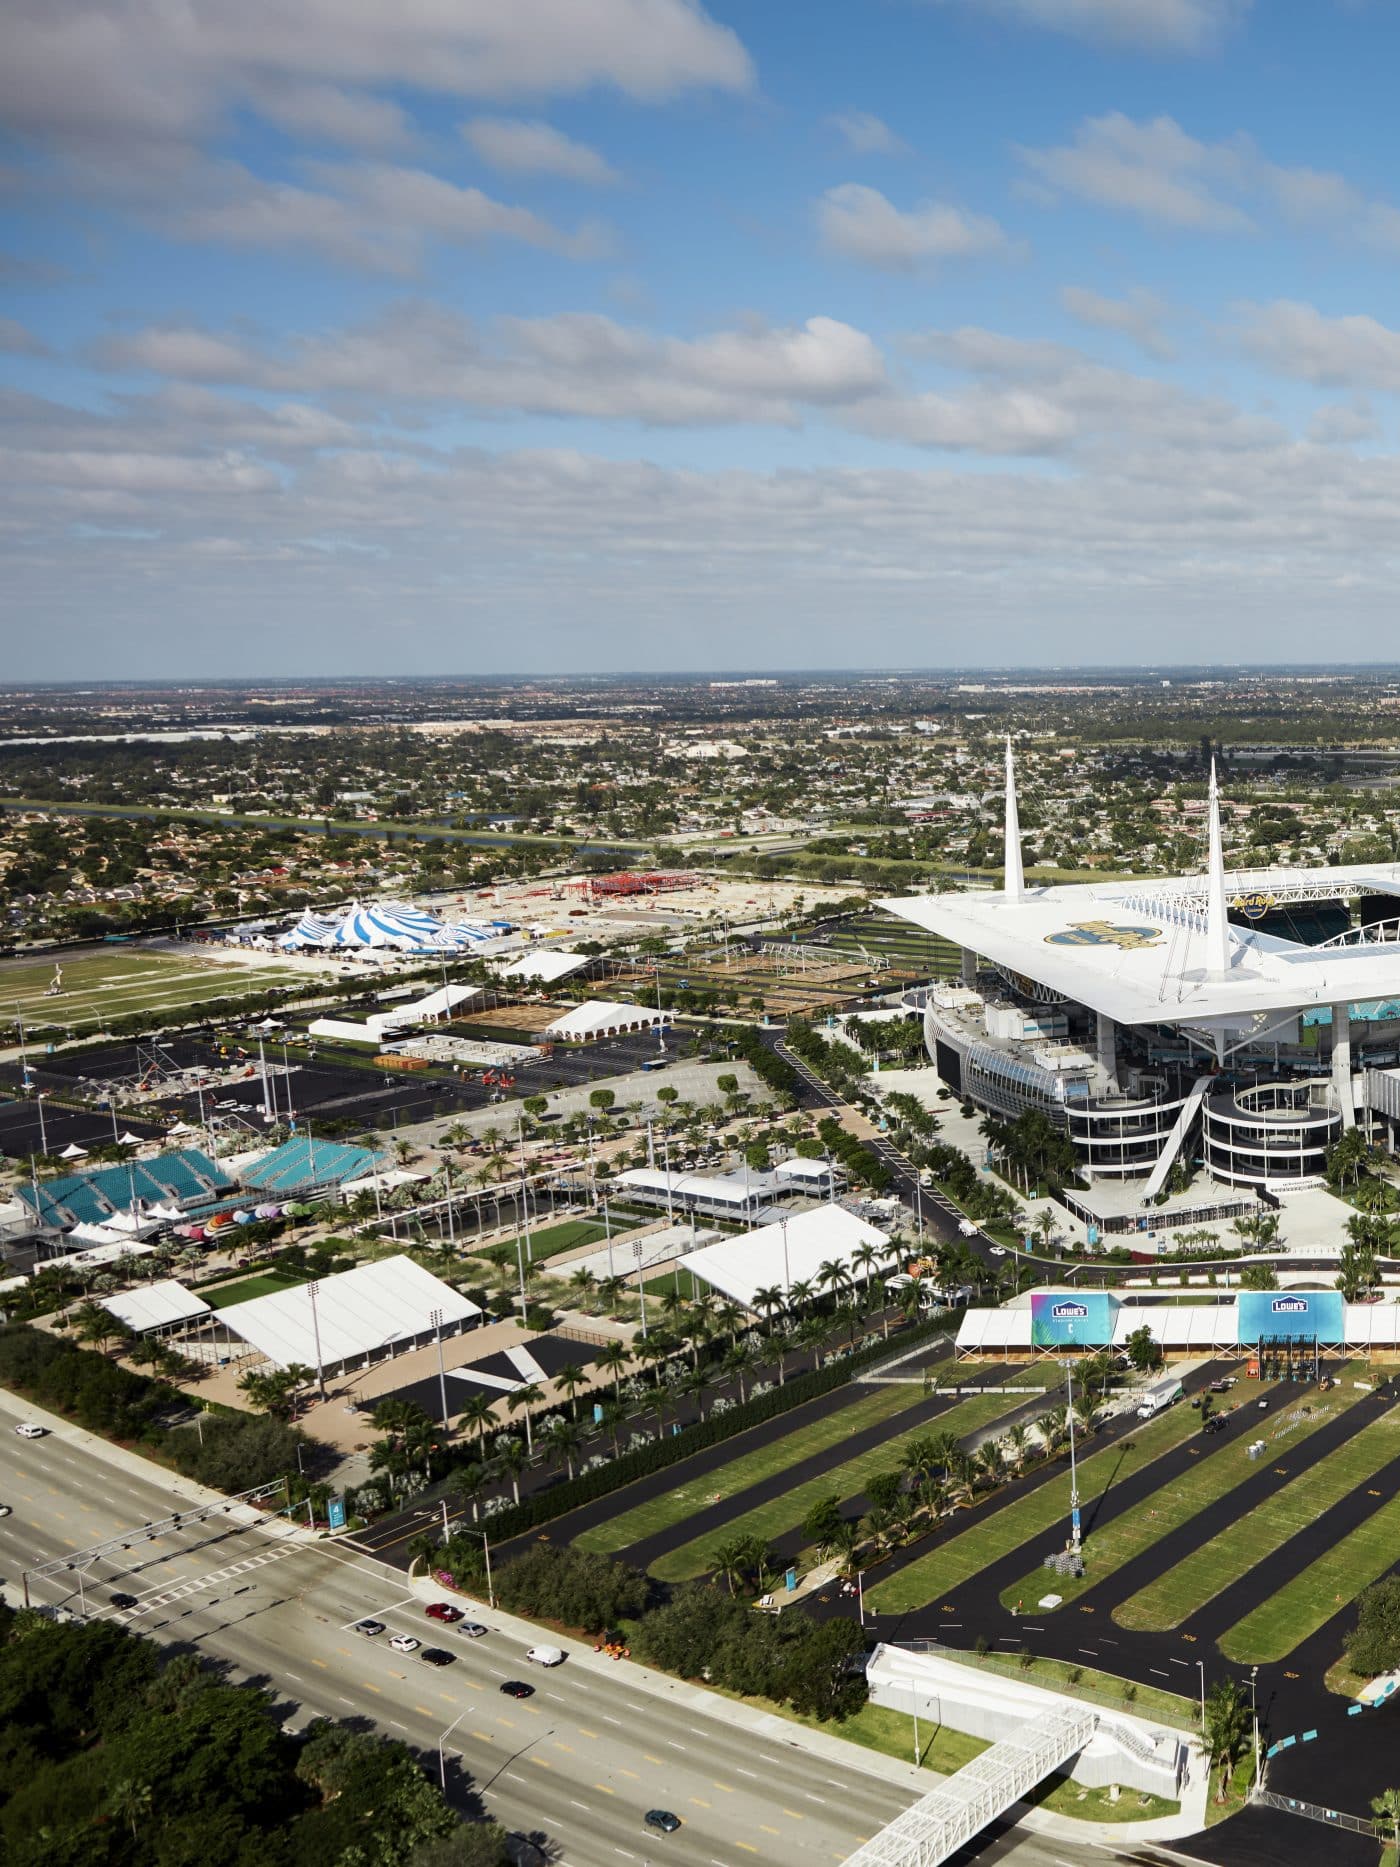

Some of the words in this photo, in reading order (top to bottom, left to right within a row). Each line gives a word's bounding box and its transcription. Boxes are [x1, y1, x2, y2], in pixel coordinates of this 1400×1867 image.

[1255, 895, 1276, 907] Rock
[1275, 1301, 1306, 1311] LOWE'S
[1055, 1307, 1085, 1316] LOWE'S
